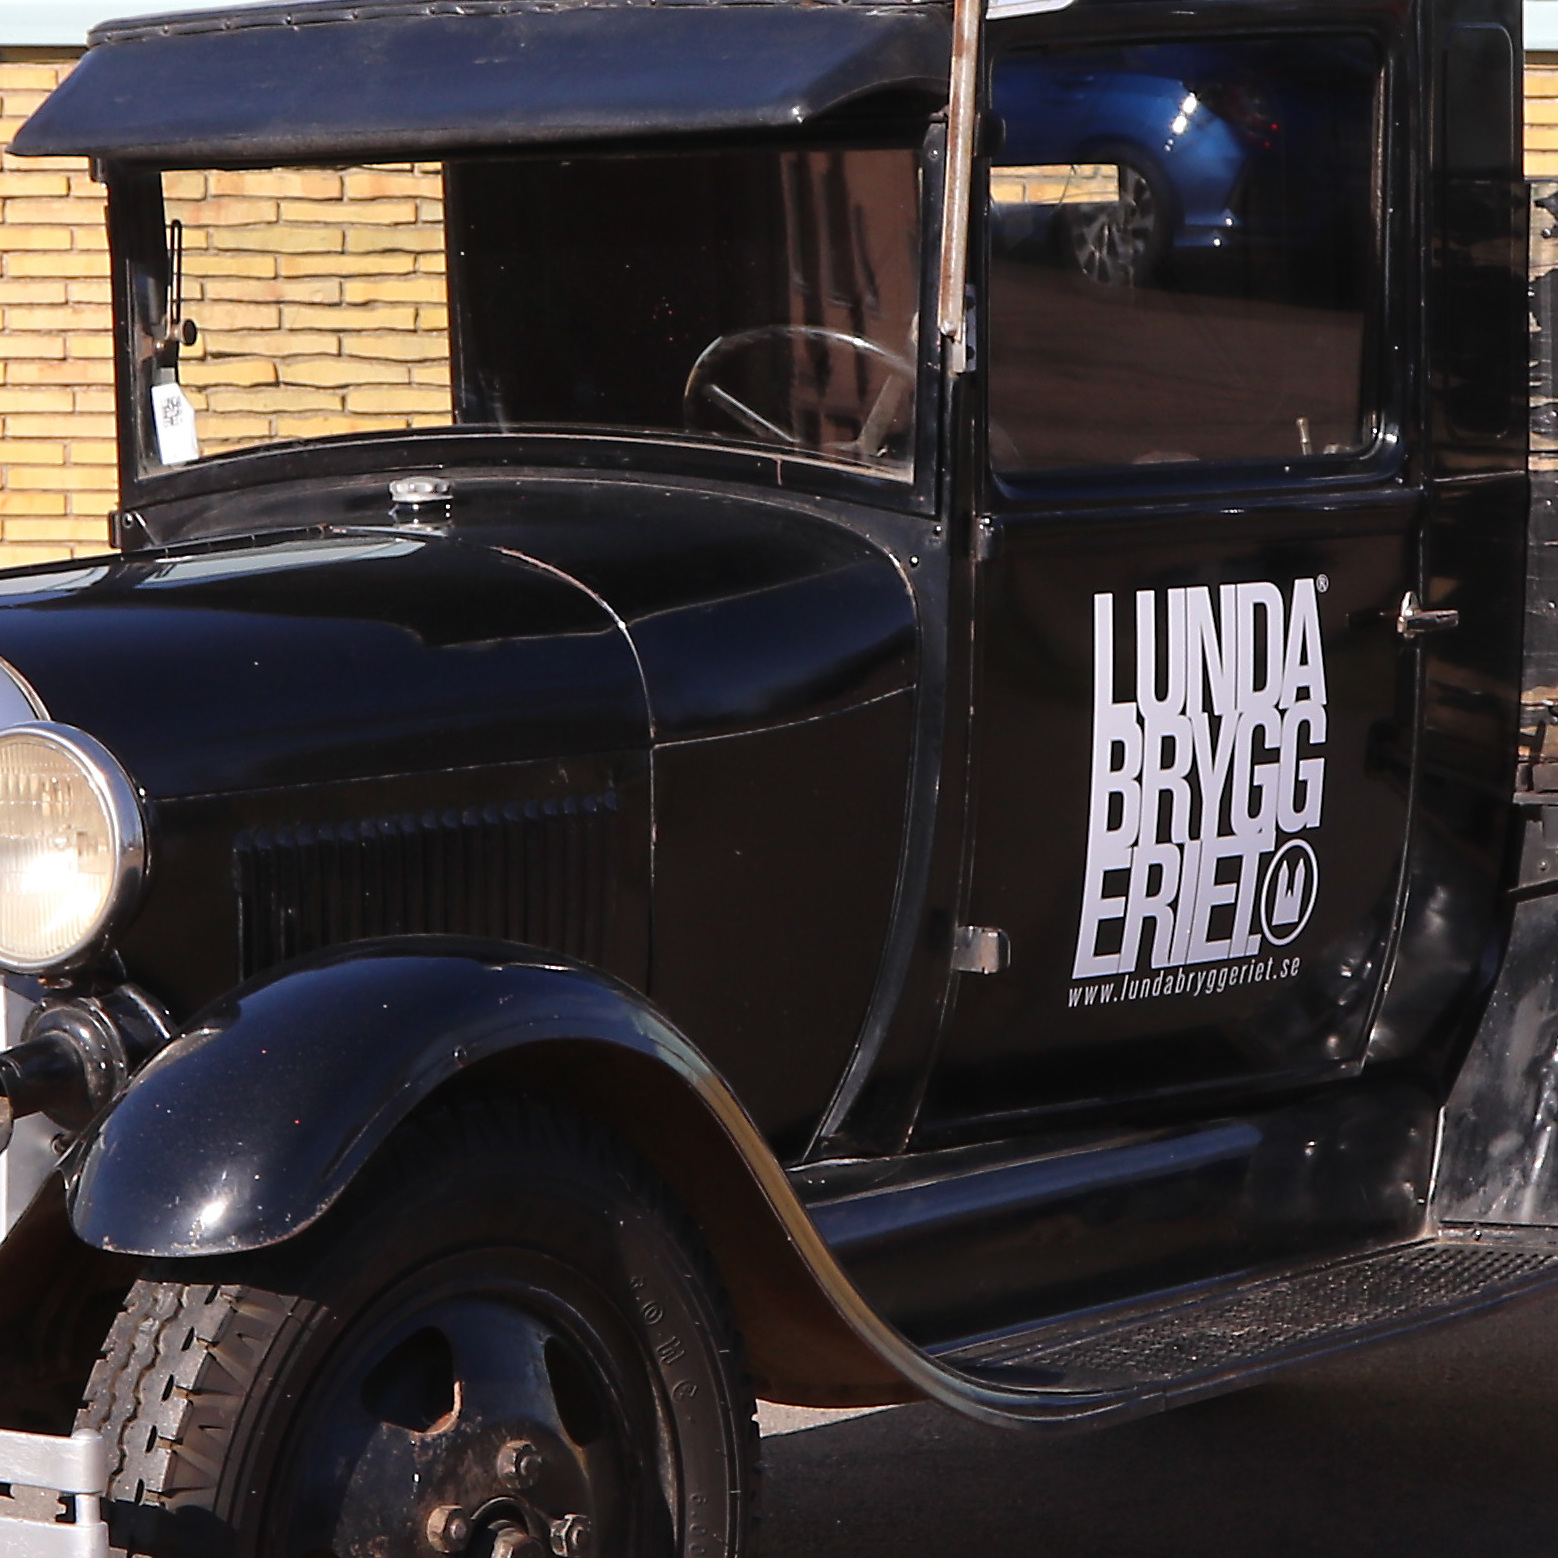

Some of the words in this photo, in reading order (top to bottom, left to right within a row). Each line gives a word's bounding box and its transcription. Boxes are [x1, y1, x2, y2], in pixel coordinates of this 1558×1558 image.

[1092, 577, 1327, 717] LUNDA
[1088, 699, 1327, 848] BRYGG
[1067, 955, 1301, 1008] www.lundabryggeriet.se
